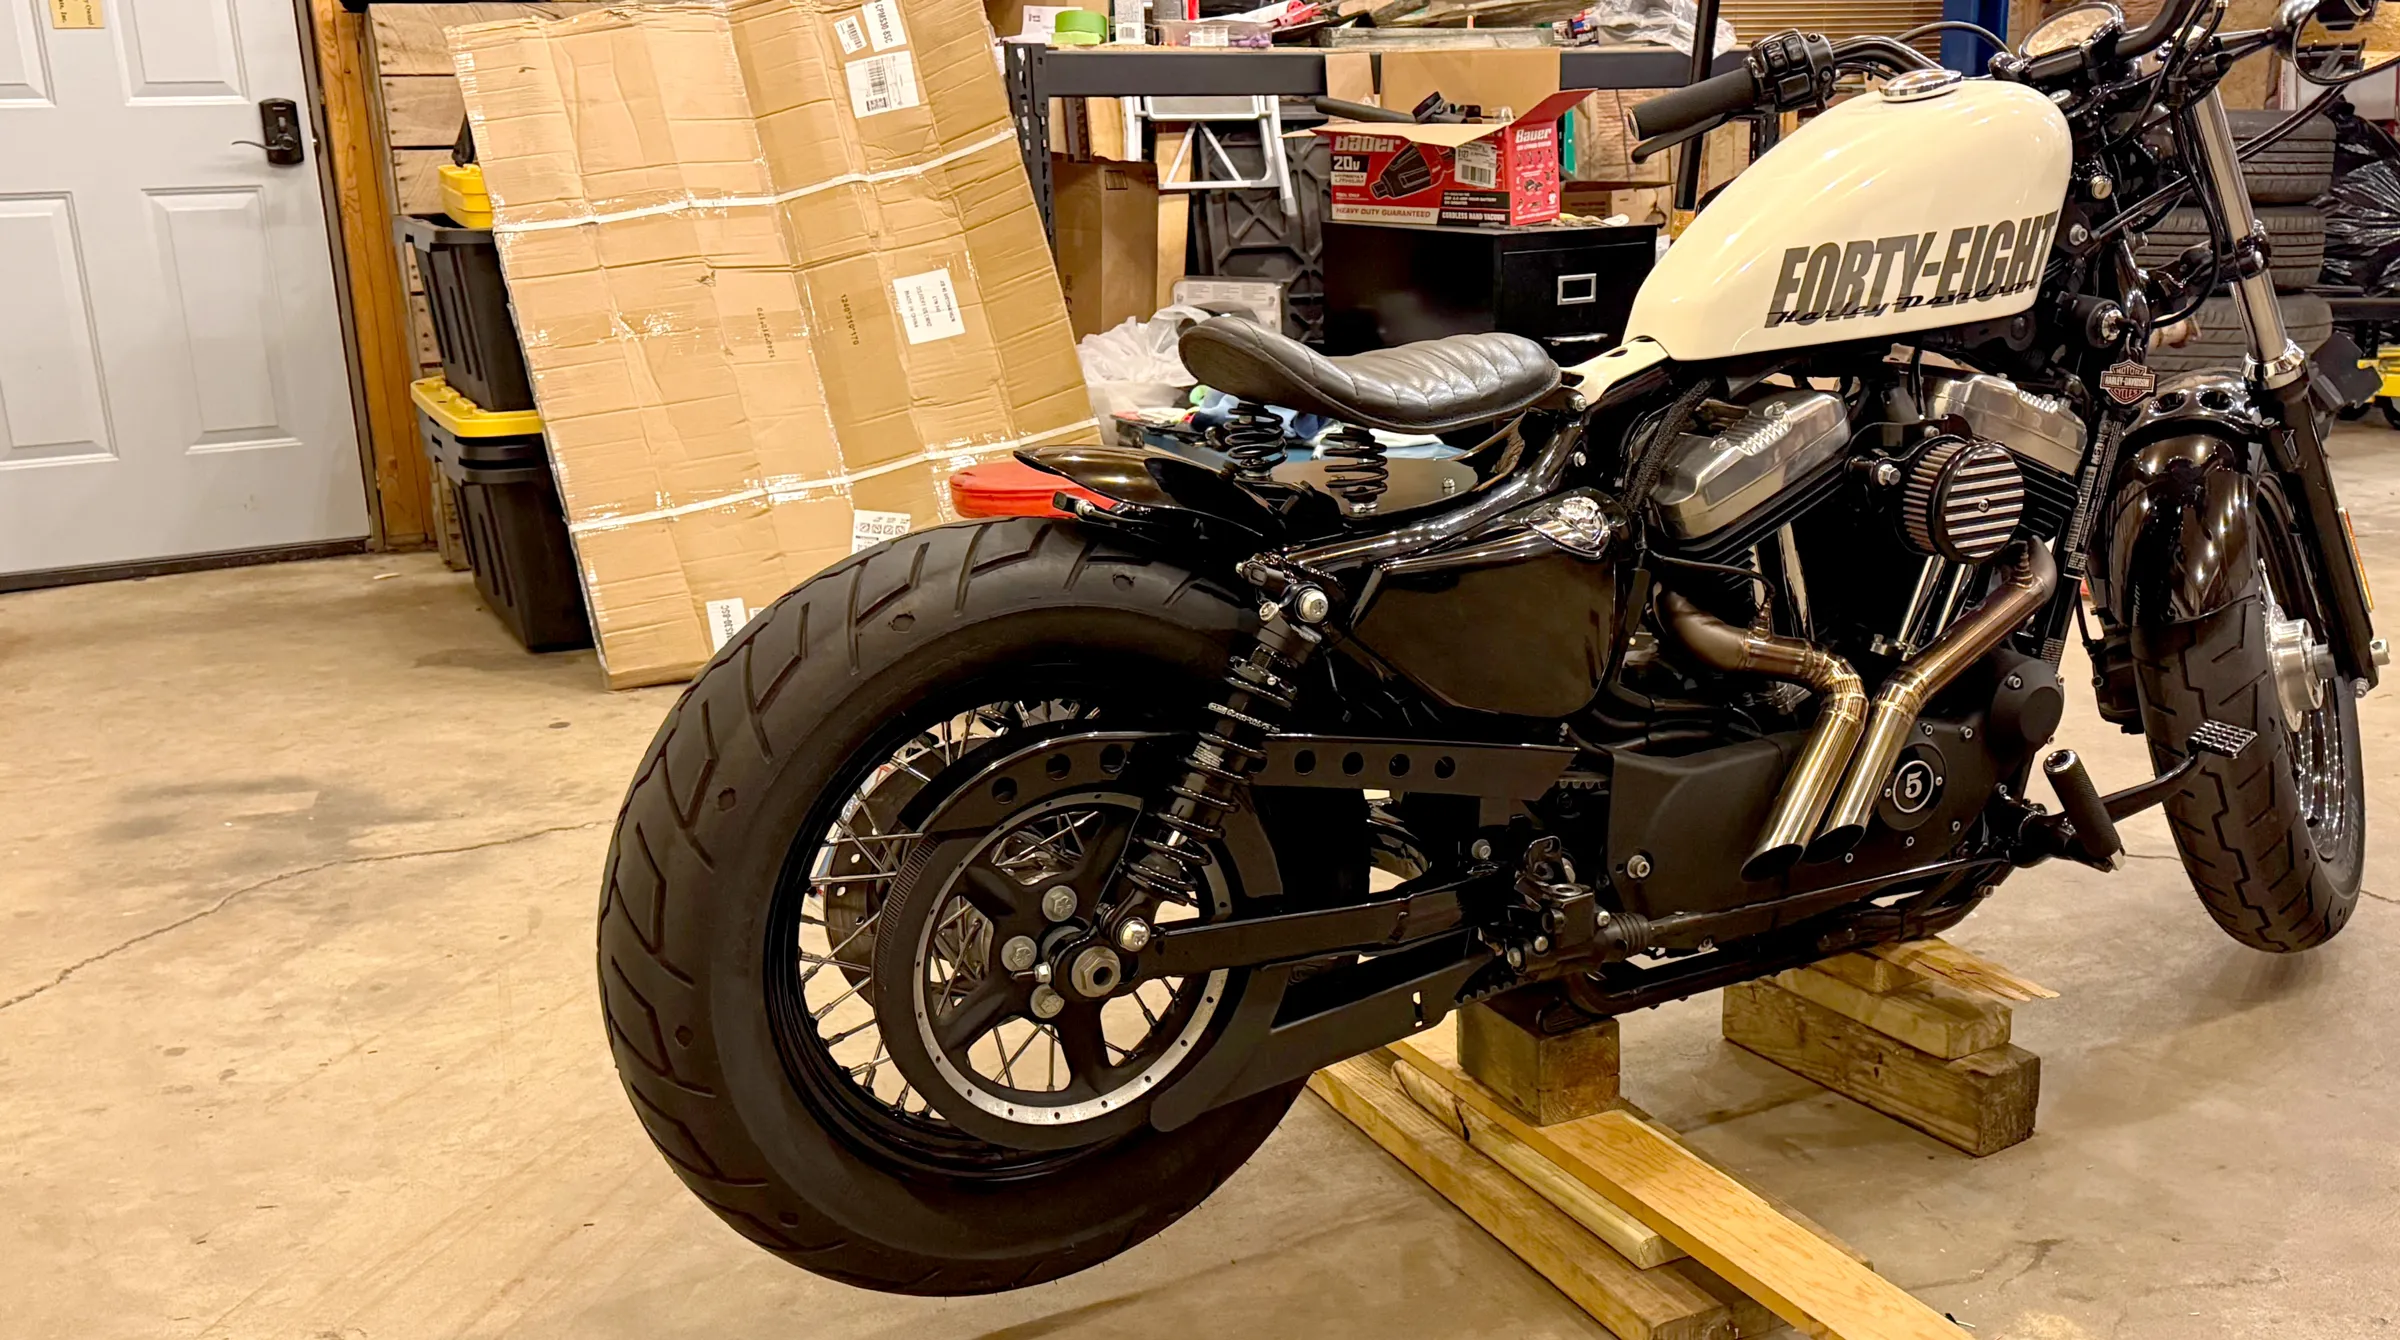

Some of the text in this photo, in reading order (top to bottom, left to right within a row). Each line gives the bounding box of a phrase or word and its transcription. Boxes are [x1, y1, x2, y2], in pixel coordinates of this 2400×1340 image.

[1515, 128, 1552, 144] Bauer
[1336, 207, 1431, 218] HEAVY DUTY GUARANTEED
[1441, 212, 1468, 220] CORDLESS
[1469, 212, 1483, 220] HAND
[1484, 213, 1506, 221] VACUUM
[1764, 210, 2059, 328] FORTY-EIGHT
[1767, 279, 2037, 325] Harley-Davidson
[2115, 365, 2145, 376] MOTOR
[2104, 375, 2150, 388] HARLEY-DAVIDSON
[2113, 388, 2142, 400] CYCLES
[1905, 771, 1922, 798] 5
